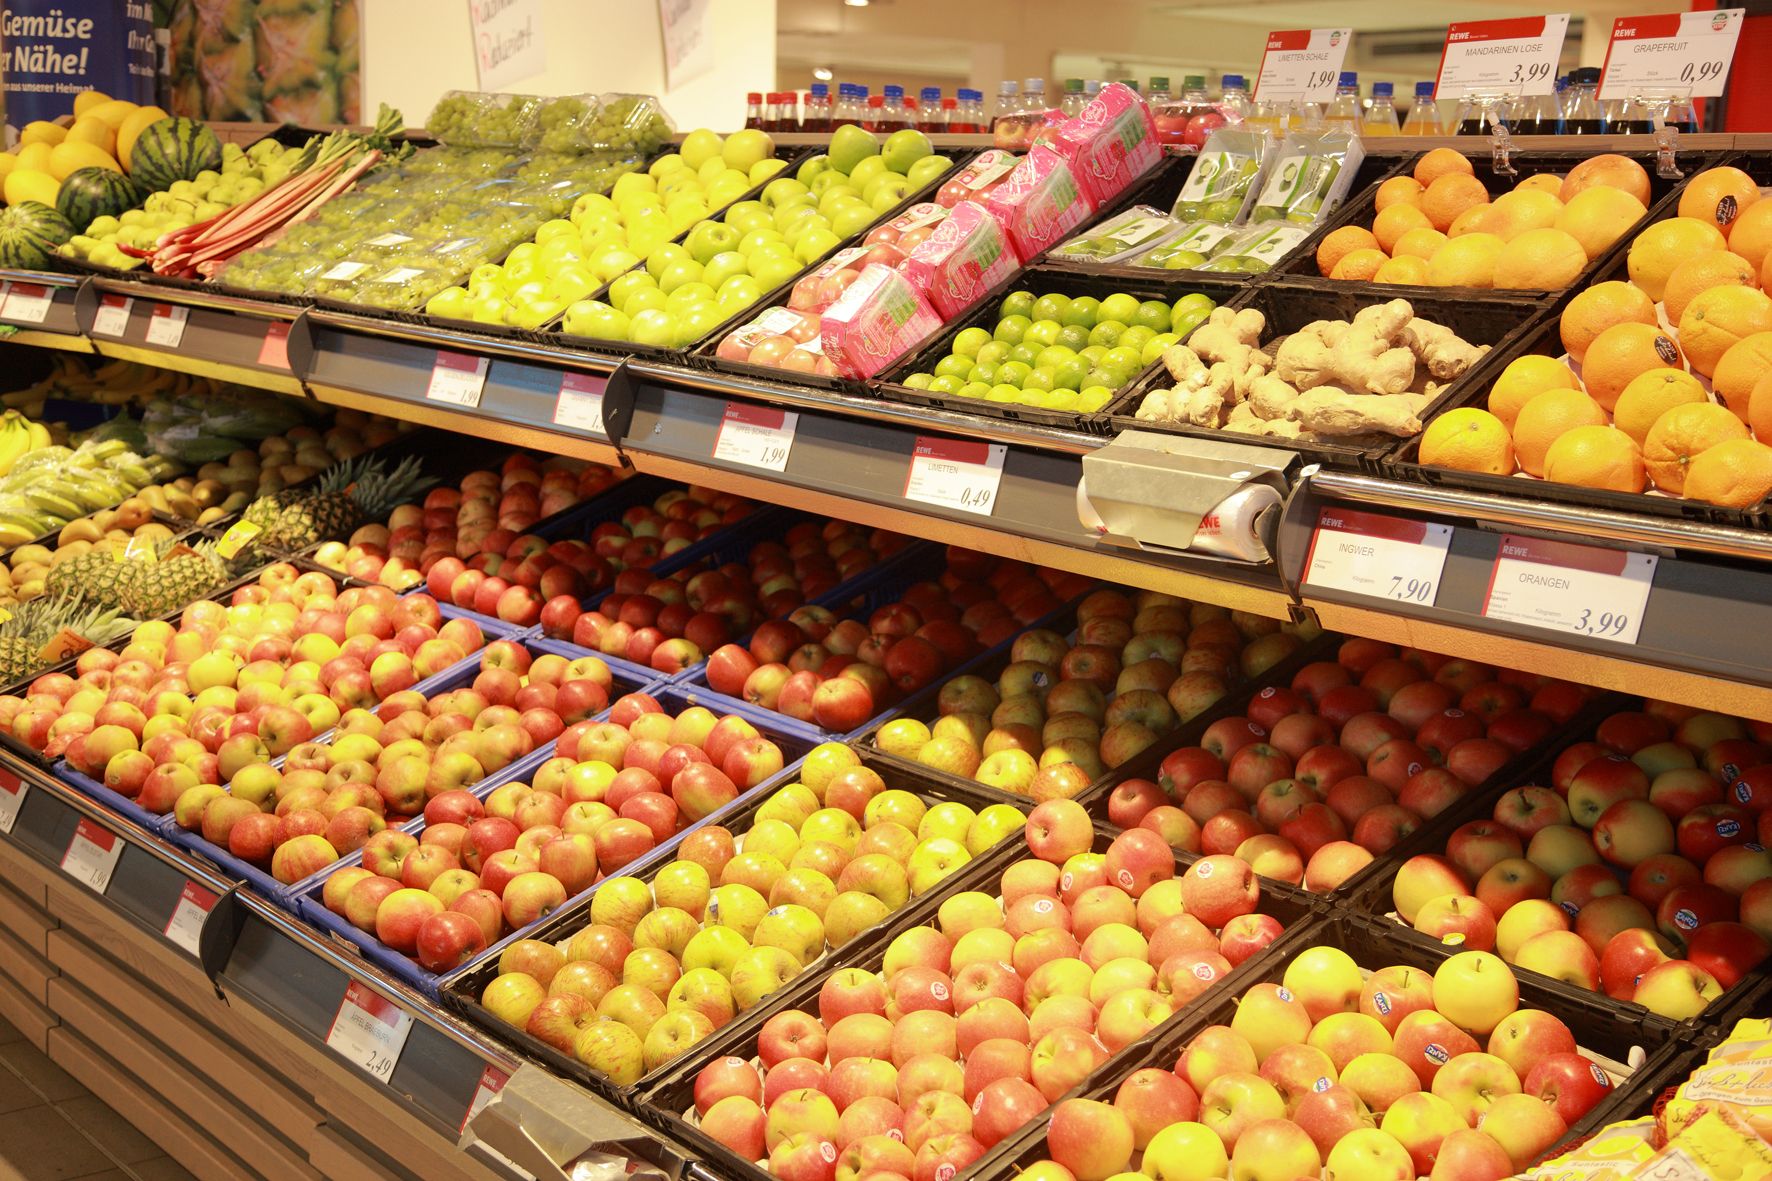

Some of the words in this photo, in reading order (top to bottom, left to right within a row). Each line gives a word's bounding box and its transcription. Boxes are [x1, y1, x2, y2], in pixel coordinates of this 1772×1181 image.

[2, 9, 94, 39] Gemüse
[1449, 32, 1470, 41] REWE
[1614, 28, 1636, 38] REWE
[1465, 46, 1519, 57] MANDARINEN
[1520, 44, 1543, 53] LOSE
[1633, 42, 1688, 54] GRAPEFRUIT
[14, 45, 89, 75] Nähe!
[1278, 54, 1305, 62] LIMETTEN
[1306, 52, 1329, 61] SCHALE
[1306, 70, 1335, 91] 1,99
[1509, 62, 1551, 84] 3,99
[1680, 61, 1723, 85] 0,99
[760, 446, 786, 464] 1,99
[916, 446, 932, 455] REWE
[928, 463, 958, 475] LIMETTEN
[960, 487, 991, 507] 0,49
[1321, 517, 1343, 528] REWE
[1339, 543, 1375, 557] INGWER
[1502, 545, 1528, 558] REWE
[1387, 575, 1432, 602] 7,90
[1518, 573, 1570, 590] ORANGEN
[1574, 608, 1628, 637] 3,99
[1425, 1045, 1448, 1062] KANZI
[366, 1050, 392, 1076] 2,49
